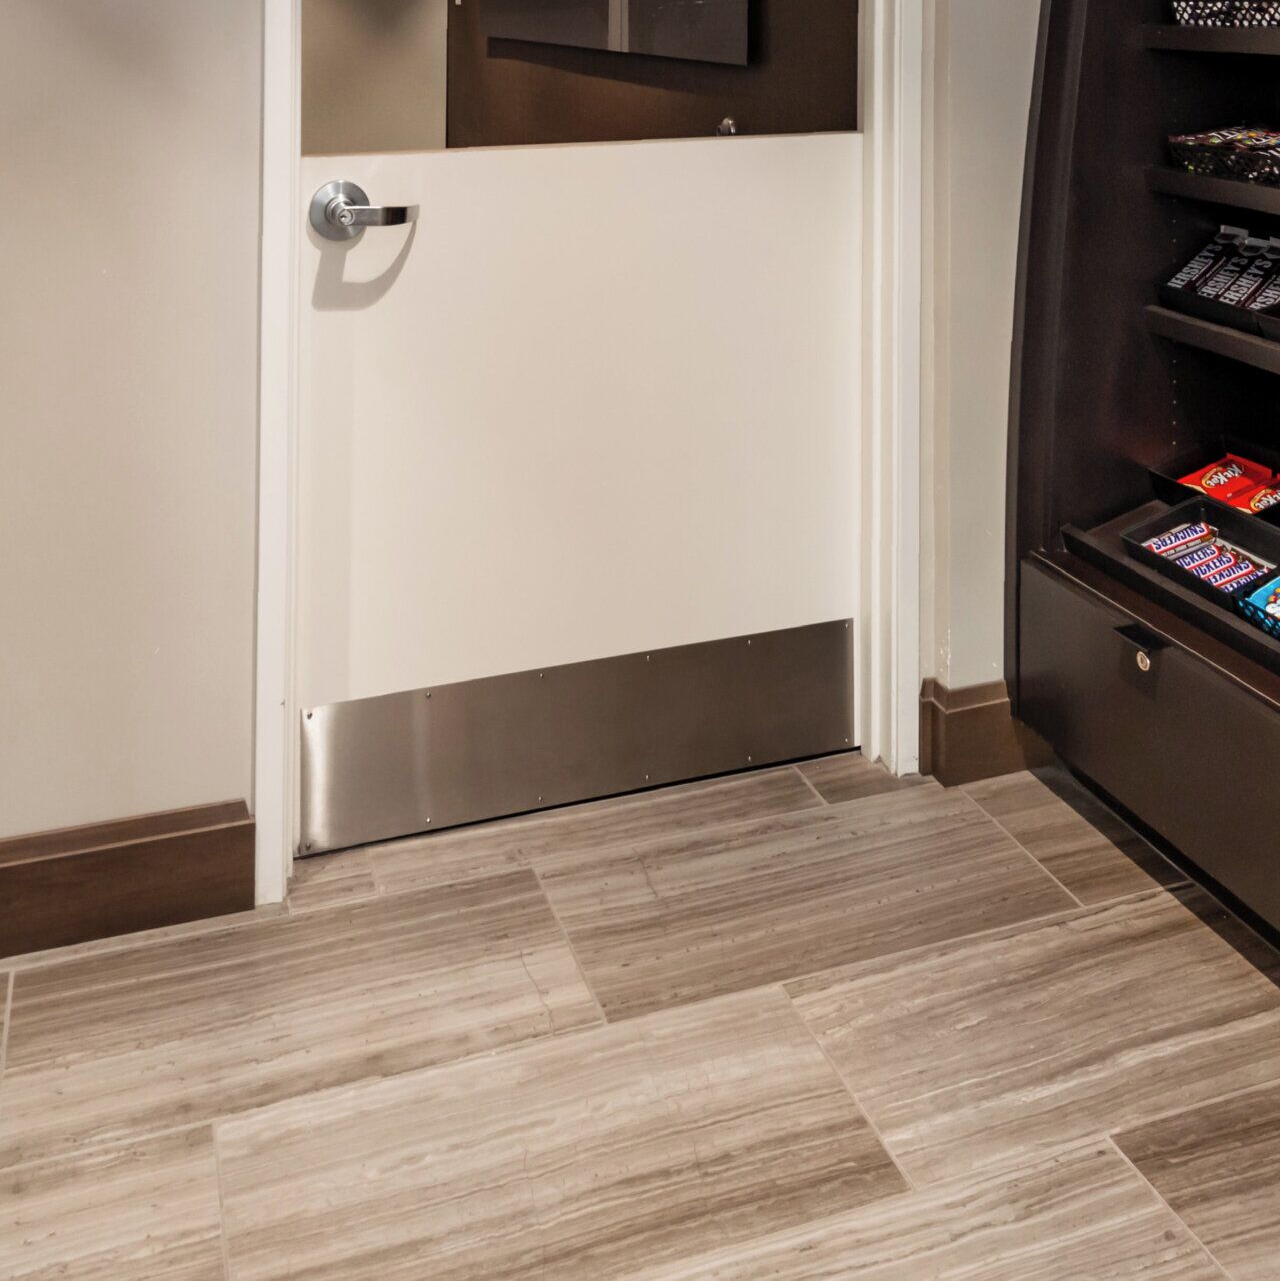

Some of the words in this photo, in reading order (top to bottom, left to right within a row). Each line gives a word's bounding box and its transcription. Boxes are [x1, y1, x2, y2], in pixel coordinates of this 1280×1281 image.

[1198, 256, 1249, 299] ERSHEY'S
[1219, 258, 1273, 306] ERSHEY'S
[1152, 523, 1206, 551] SNICKERS
[1176, 544, 1217, 568] ICKERS
[1193, 553, 1233, 576] ICKERS
